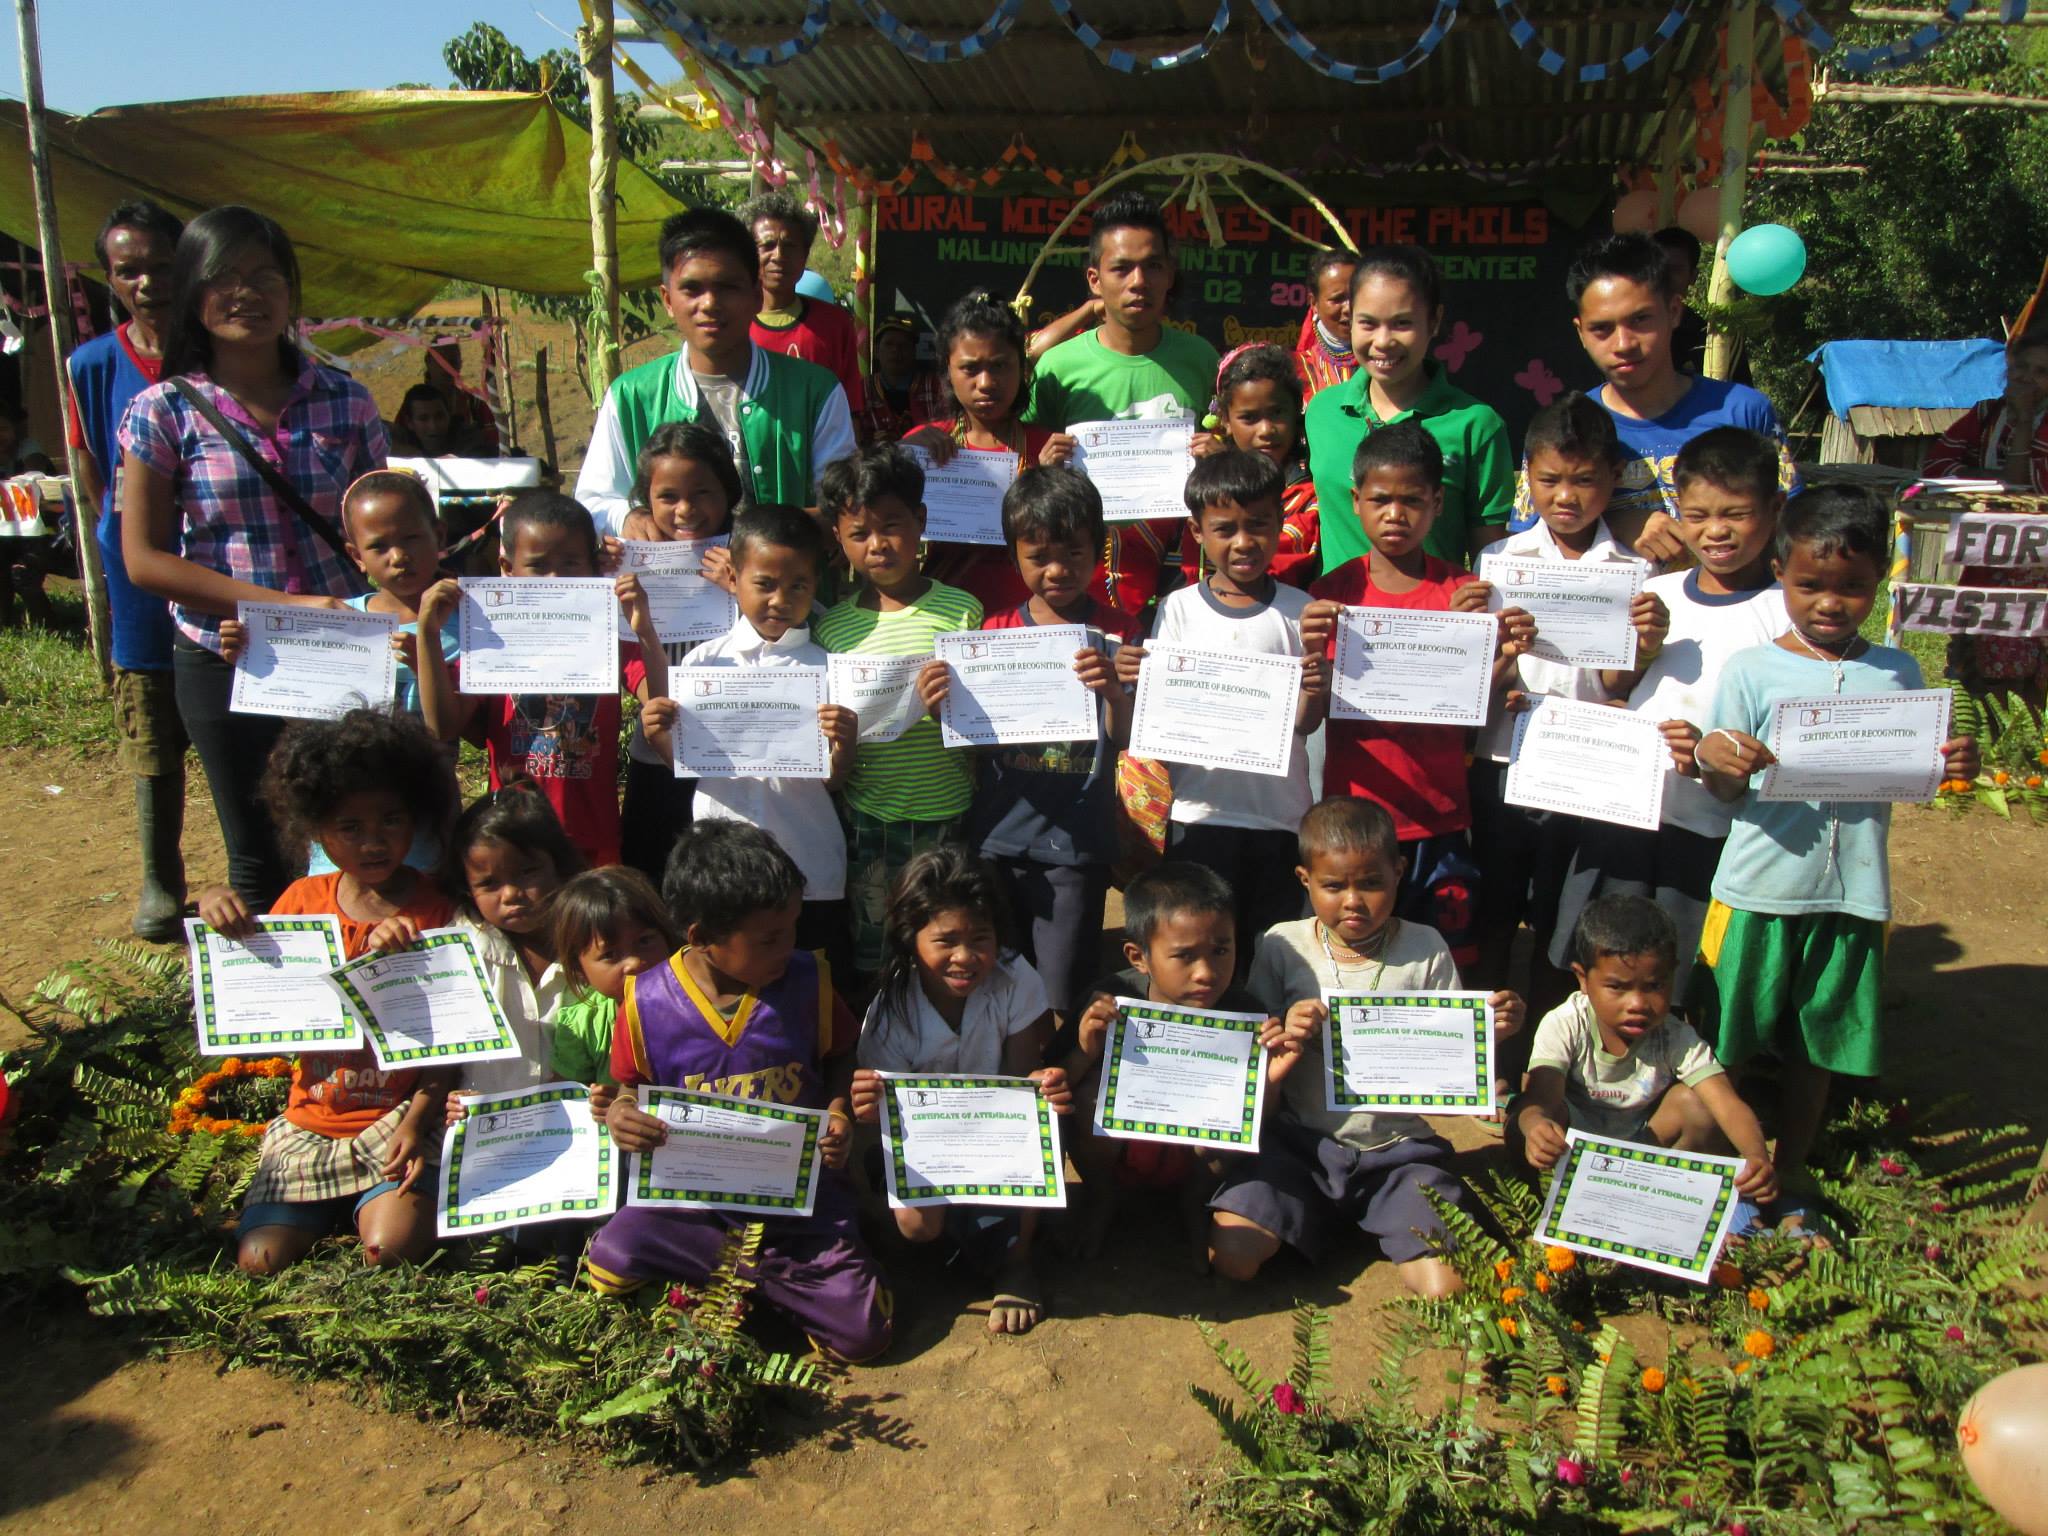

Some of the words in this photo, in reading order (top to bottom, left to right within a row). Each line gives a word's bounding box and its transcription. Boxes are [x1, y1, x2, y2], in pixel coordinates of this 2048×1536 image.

[878, 195, 987, 232] RURAL
[1345, 206, 1416, 245] THE
[1428, 206, 1549, 245] PHILS
[1270, 282, 1307, 307] 20
[1131, 448, 1173, 457] RECOGNITION
[1953, 521, 2048, 566] FOR
[1505, 591, 1550, 600] CERTIFICATE
[1551, 592, 1562, 601] OF
[1562, 593, 1613, 604] RECOGNITION
[1898, 584, 2048, 632] VISIT
[486, 612, 530, 622] CERTIFICATE
[532, 612, 540, 620] OF
[542, 612, 591, 623] RECOGNITION
[311, 639, 321, 648] OF
[322, 640, 371, 656] RECOGNITION
[1362, 642, 1406, 651] CERTIFICATE
[1407, 642, 1417, 651] OF
[1418, 643, 1468, 656] RECOGNITION
[964, 662, 1007, 674] CERTIFICATE
[1007, 662, 1016, 671] OF
[1017, 661, 1066, 670] RECOGNITION
[1165, 678, 1210, 690] CERTIFICATE
[1211, 682, 1220, 691] OF
[1221, 683, 1271, 700] RECOGNITION
[696, 702, 738, 712] CERTIFICATE
[740, 702, 749, 710] OF
[751, 702, 800, 712] RECOGNITION
[1581, 735, 1590, 744] OF
[1799, 730, 1849, 743] CERTIFICATE
[1850, 730, 1860, 738] OF
[1861, 728, 1918, 738] RECOGNITION
[1352, 1028, 1400, 1036] CERTIFICATE
[1400, 1028, 1411, 1036] OF
[1413, 1028, 1464, 1040] ATTENDANCE
[1135, 1045, 1179, 1056] CERTIFICATE
[1180, 1048, 1190, 1057] OF
[1190, 1050, 1238, 1065] ATTENDANCE
[912, 1112, 960, 1121] CERTIFICATE
[961, 1112, 972, 1120] OF
[974, 1112, 1027, 1122] ATTENDANCE
[476, 1134, 524, 1148] CERTIFICATE
[525, 1131, 535, 1140] OF
[668, 1128, 722, 1140] CERTIFICATE
[723, 1133, 734, 1142] OF
[736, 1134, 792, 1148] ATTENDANCE
[1586, 1174, 1638, 1190] CERTIFICATE
[1639, 1184, 1650, 1194] OF
[1651, 1187, 1704, 1206] ATTENDANCE
